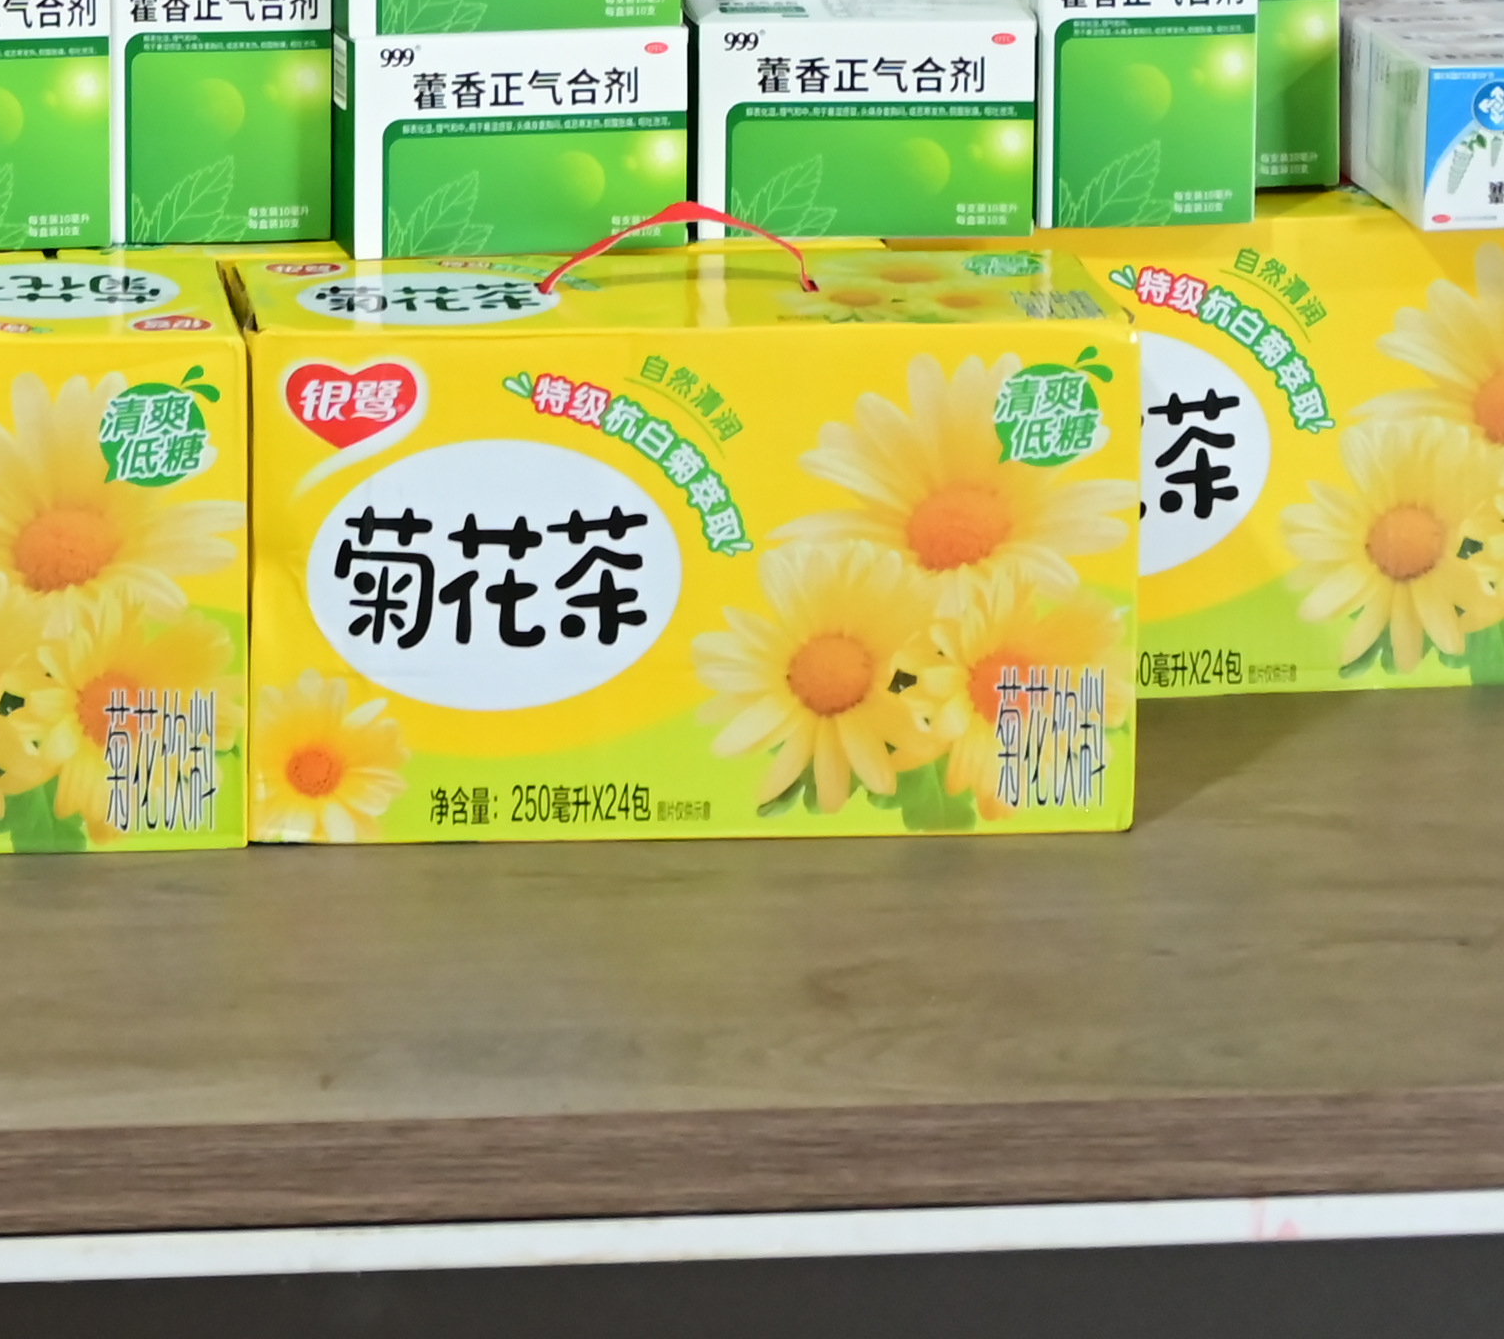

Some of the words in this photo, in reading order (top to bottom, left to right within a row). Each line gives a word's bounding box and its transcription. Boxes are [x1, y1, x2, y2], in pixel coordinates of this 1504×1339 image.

[380, 49, 414, 67] 999
[724, 33, 758, 50] 999
[414, 67, 638, 110] 藿香正气合剂
[758, 57, 984, 93] 藿香正气合剂
[316, 282, 540, 314] 菊花茶
[1233, 246, 1328, 328] 自然清润
[102, 392, 192, 439] 清爽
[299, 379, 402, 422] 银鹭
[638, 354, 745, 443] 自然清润
[996, 372, 1087, 421] 清爽
[117, 429, 204, 480] 低糖
[1009, 411, 1098, 458] 低糖
[334, 504, 648, 649] 菊花茶
[104, 689, 217, 833] 菊花饮料
[994, 666, 1106, 809] 菊花饮料
